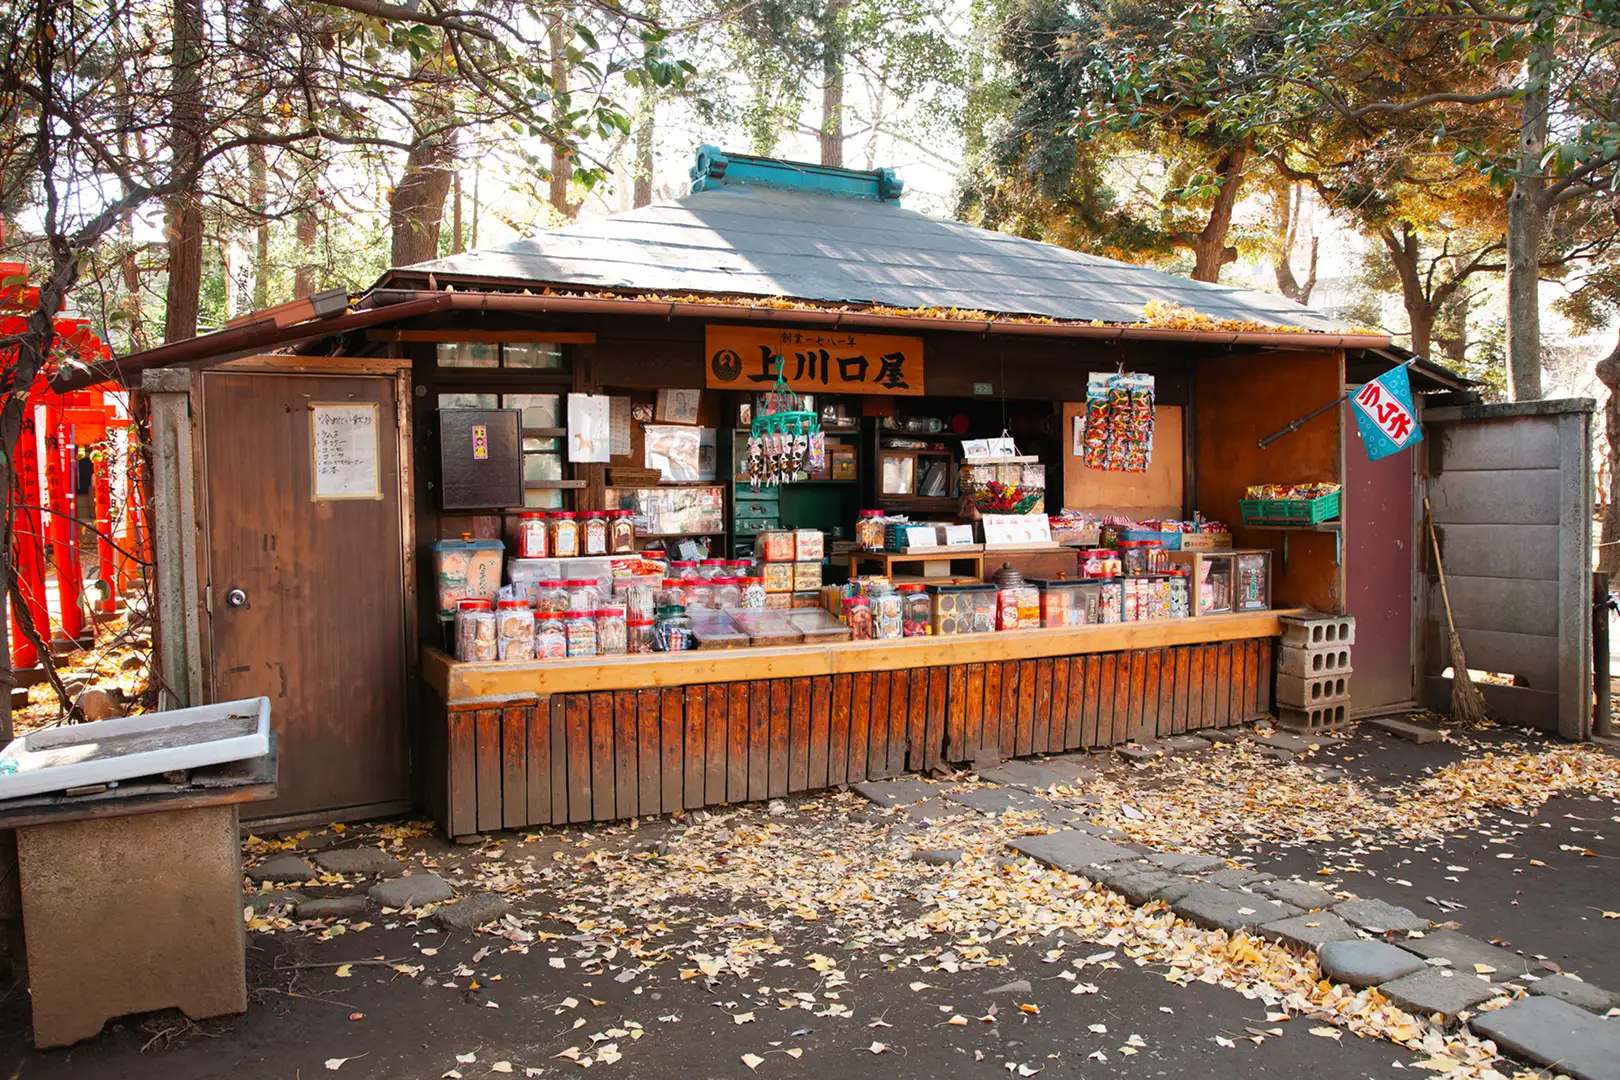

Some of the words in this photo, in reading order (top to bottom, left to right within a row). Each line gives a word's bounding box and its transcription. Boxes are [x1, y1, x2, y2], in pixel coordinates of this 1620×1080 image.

[780, 331, 857, 347] 創業一七八一年
[747, 345, 909, 390] 上川口屋
[1358, 383, 1412, 440] ラムネ
[1003, 610, 1017, 620] ビスコ
